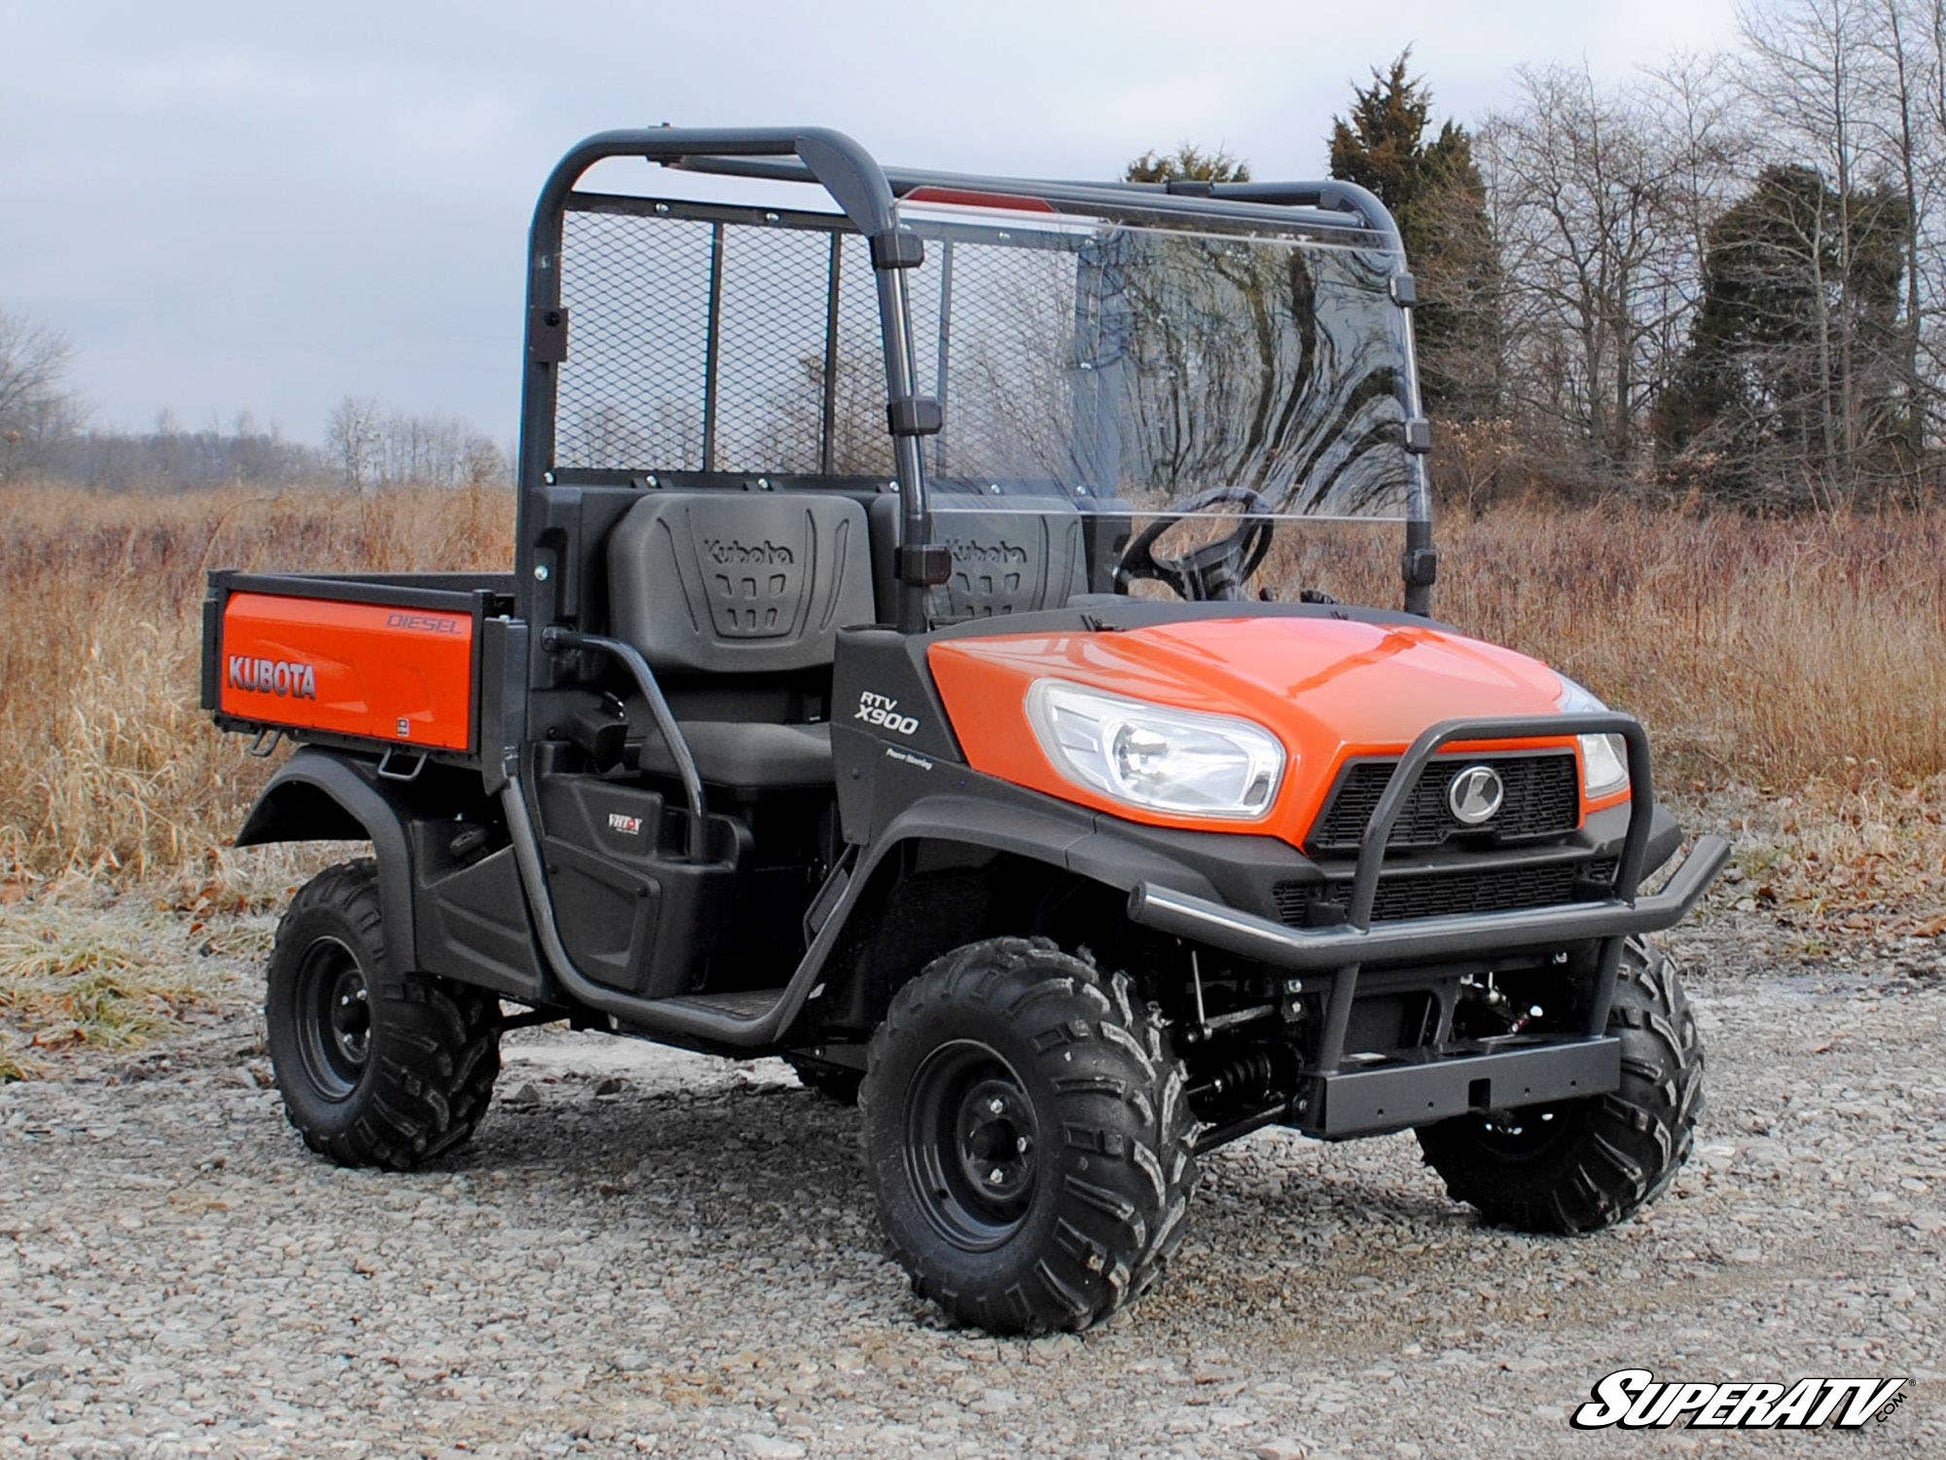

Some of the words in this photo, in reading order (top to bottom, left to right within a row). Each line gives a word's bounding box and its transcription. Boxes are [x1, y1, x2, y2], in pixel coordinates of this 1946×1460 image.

[704, 539, 794, 565] Kubota
[945, 539, 1028, 564] Kubota
[386, 612, 462, 636] DIESEL
[228, 654, 317, 700] KUBOTA
[860, 691, 898, 711] RTV
[854, 704, 919, 735] X900
